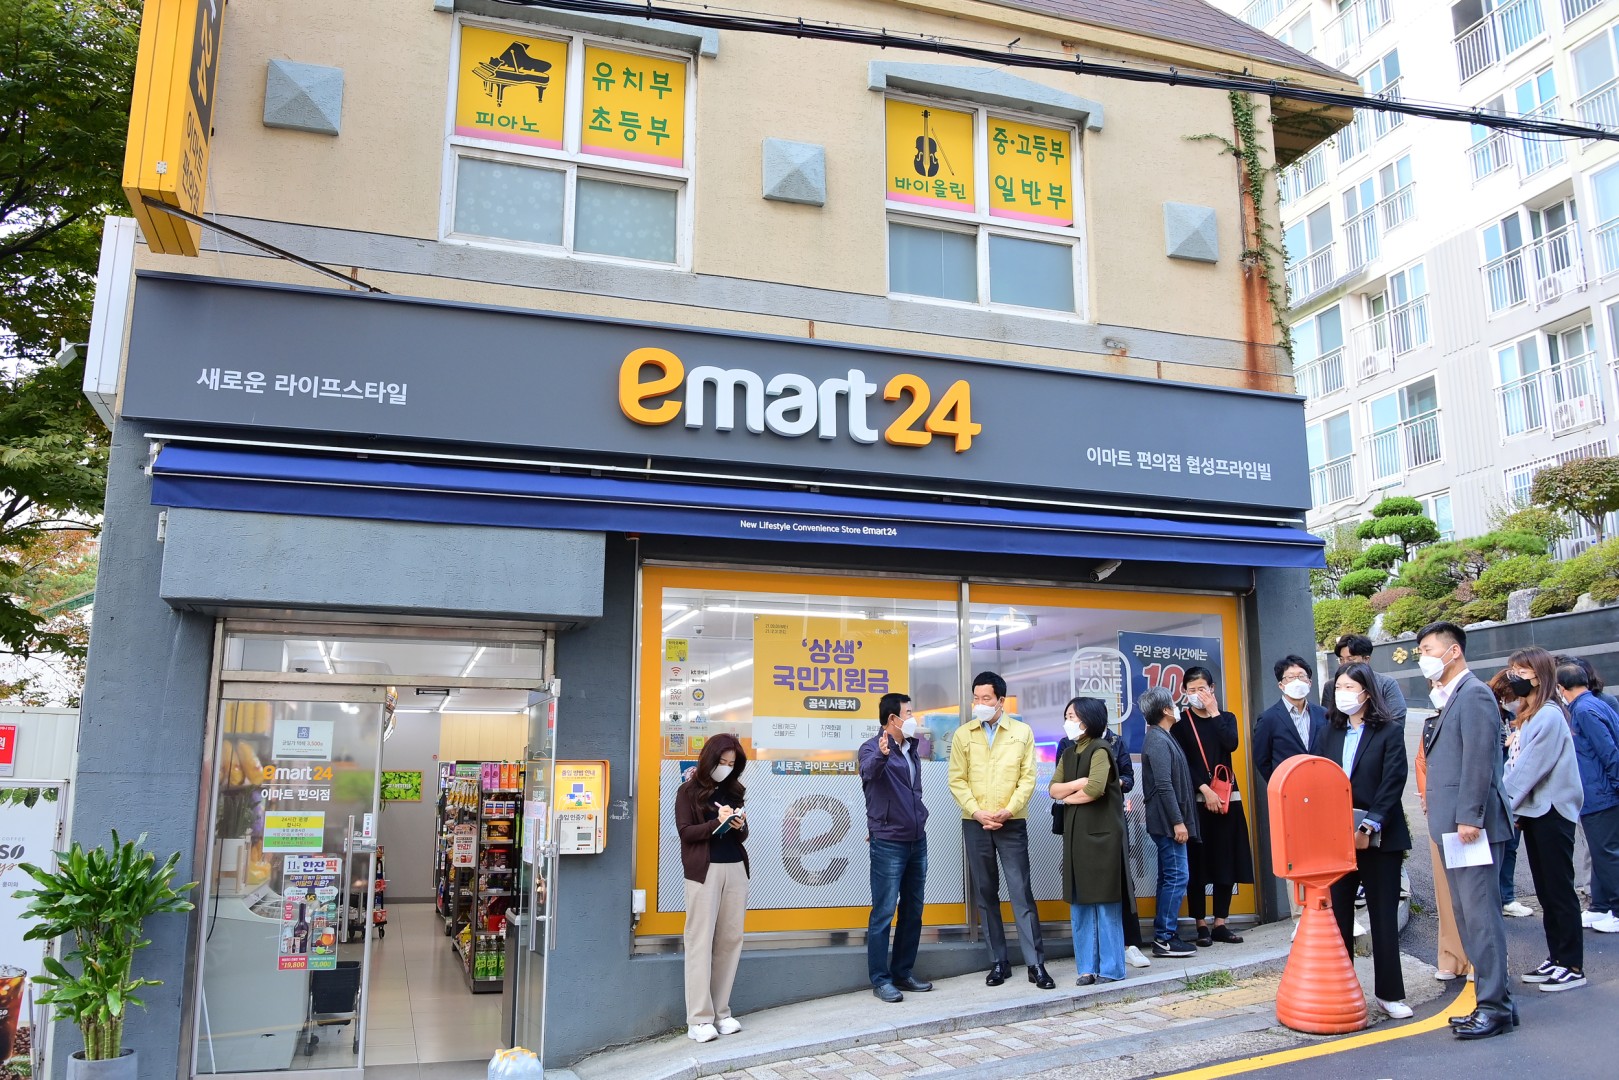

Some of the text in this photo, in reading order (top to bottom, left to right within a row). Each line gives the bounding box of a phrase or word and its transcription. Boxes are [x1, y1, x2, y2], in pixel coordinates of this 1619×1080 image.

[592, 62, 672, 100] 유치부
[475, 111, 540, 133] 피아노
[589, 106, 670, 146] 초등부
[895, 176, 966, 200] 바이올린
[994, 174, 1066, 210] 일반부
[196, 367, 408, 406] 새로운 라이프스타일
[618, 346, 983, 454] emart24
[1086, 446, 1272, 482] 이마트 편의점 협성프라임빌
[740, 519, 898, 536] New Lifestyle Convenience Store emart24
[1132, 644, 1208, 661] 무인 운영 시간에는
[772, 664, 890, 694] 국민지원금
[1080, 661, 1122, 677] FREE
[1080, 678, 1123, 694] ZONE
[1142, 662, 1189, 706] 10
[808, 698, 856, 711] 공식 사용처
[262, 764, 334, 781] emart24
[777, 761, 856, 772] 새로운 라이프스타일
[261, 788, 331, 801] 이마트 편의점
